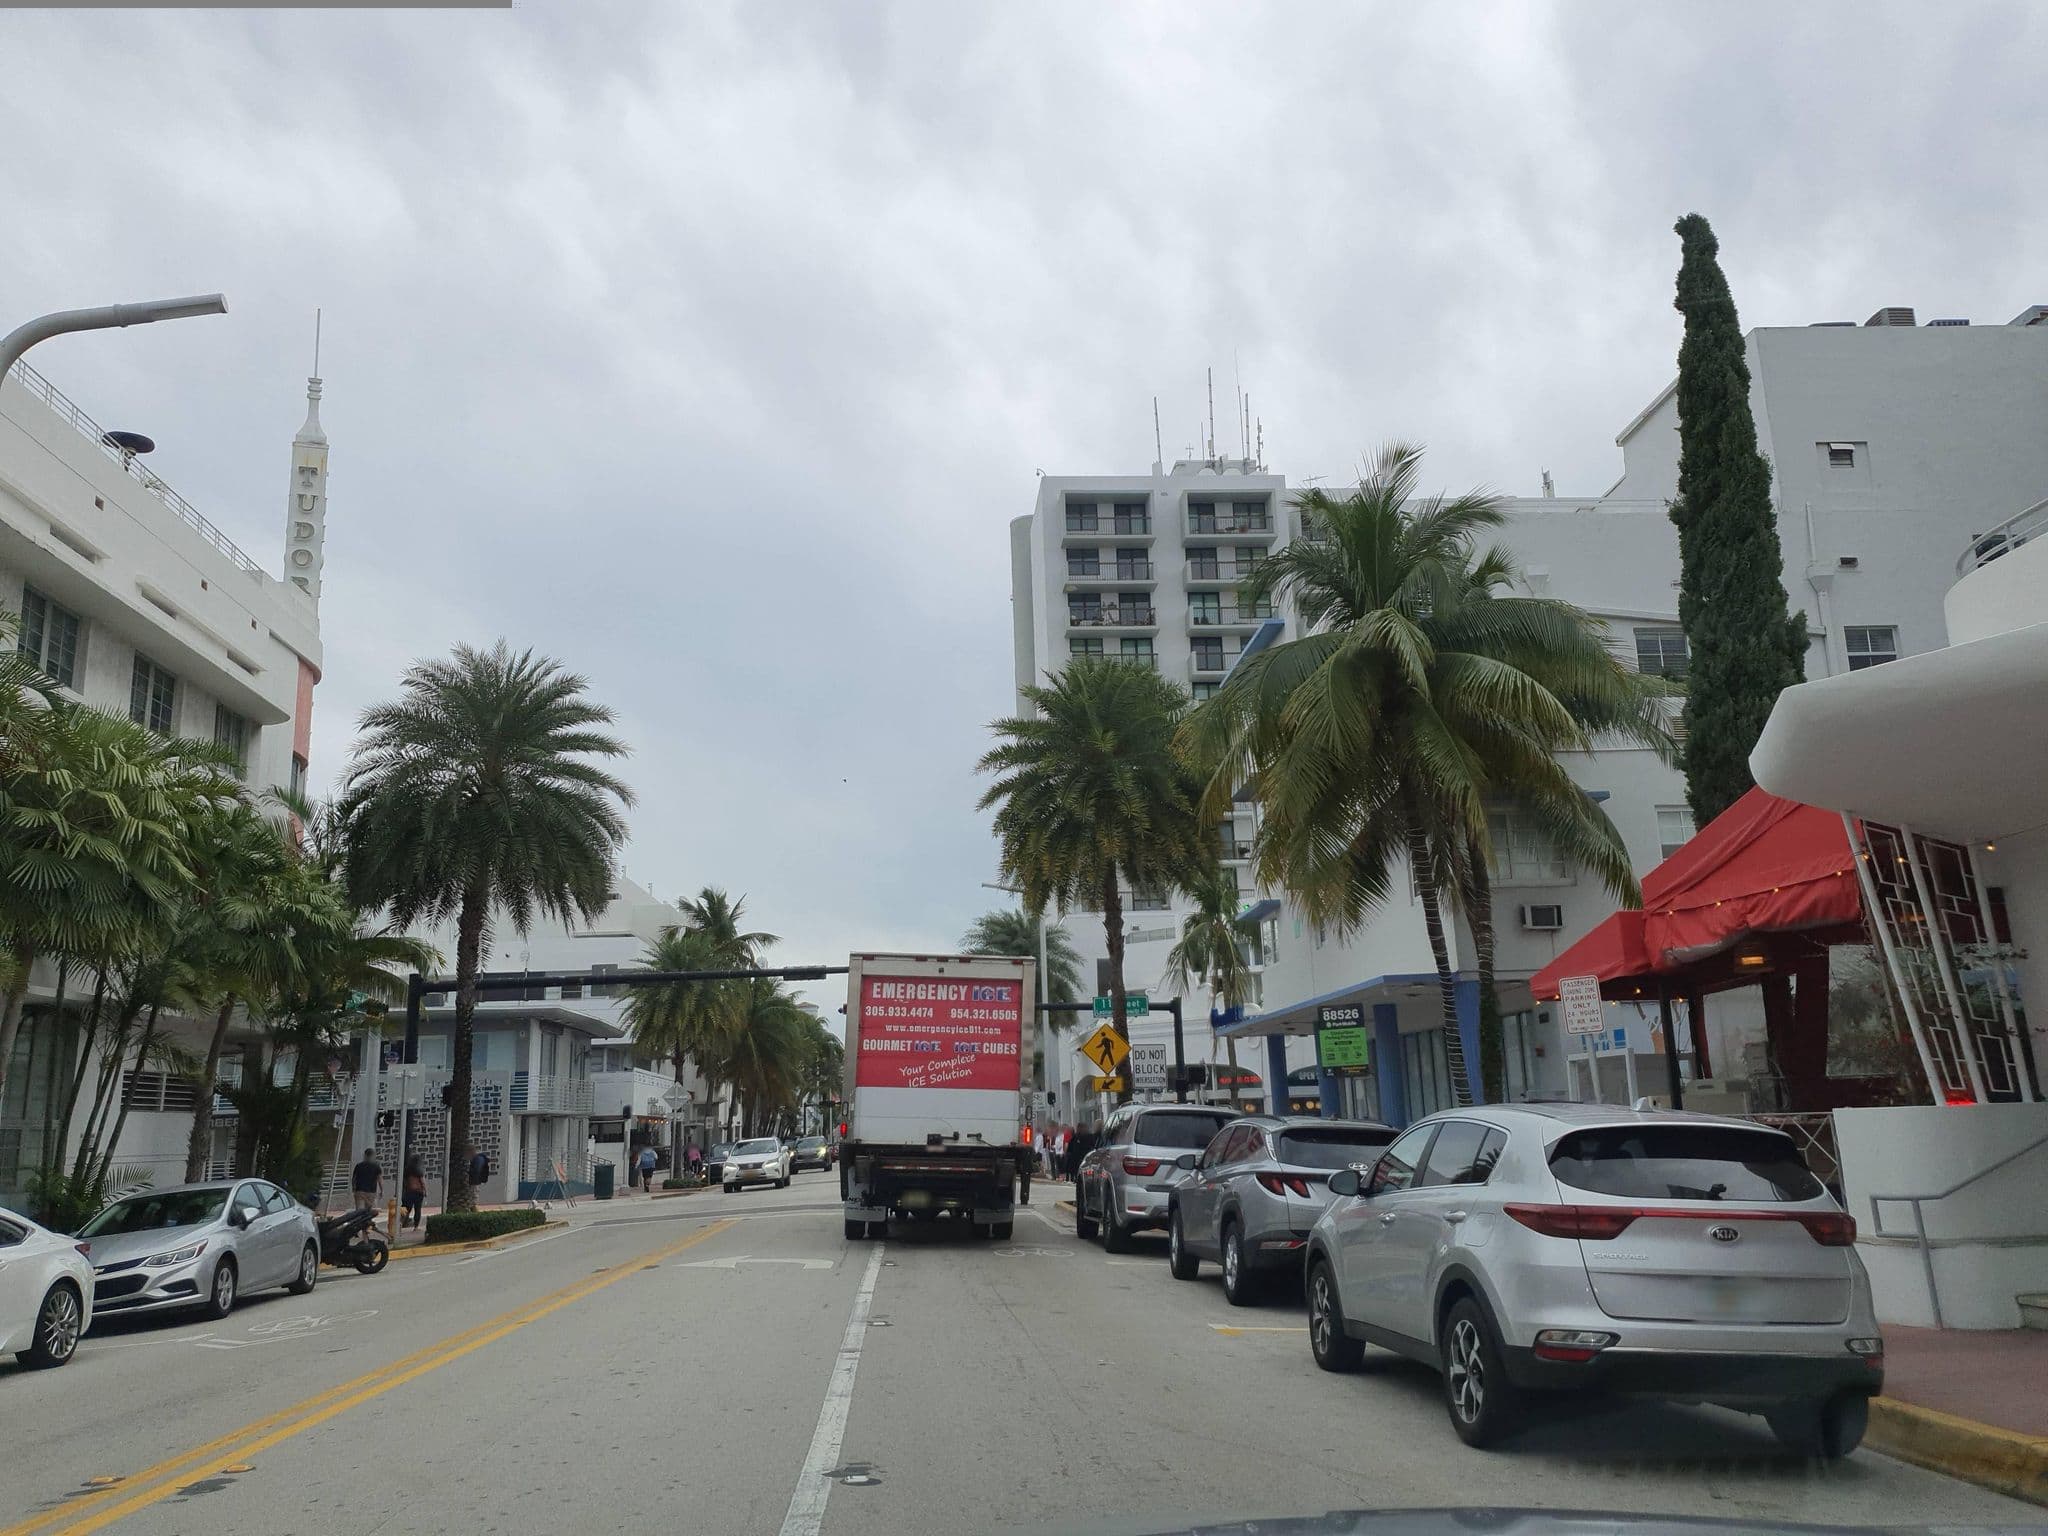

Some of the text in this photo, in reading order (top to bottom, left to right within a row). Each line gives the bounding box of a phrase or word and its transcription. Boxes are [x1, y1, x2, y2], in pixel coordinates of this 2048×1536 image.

[872, 983, 1012, 1002] EMERGENCY ICE
[1565, 994, 1597, 1002] PARKING
[1323, 1009, 1359, 1021] 88526
[862, 1039, 1018, 1055] GOURMET ICE ICE CUBES
[1135, 1050, 1164, 1060] DO NOT
[898, 1054, 976, 1077] Your Complete
[1135, 1064, 1166, 1075] BLOCK
[908, 1068, 973, 1089] ICE Solution
[1715, 1229, 1737, 1240] KIA
